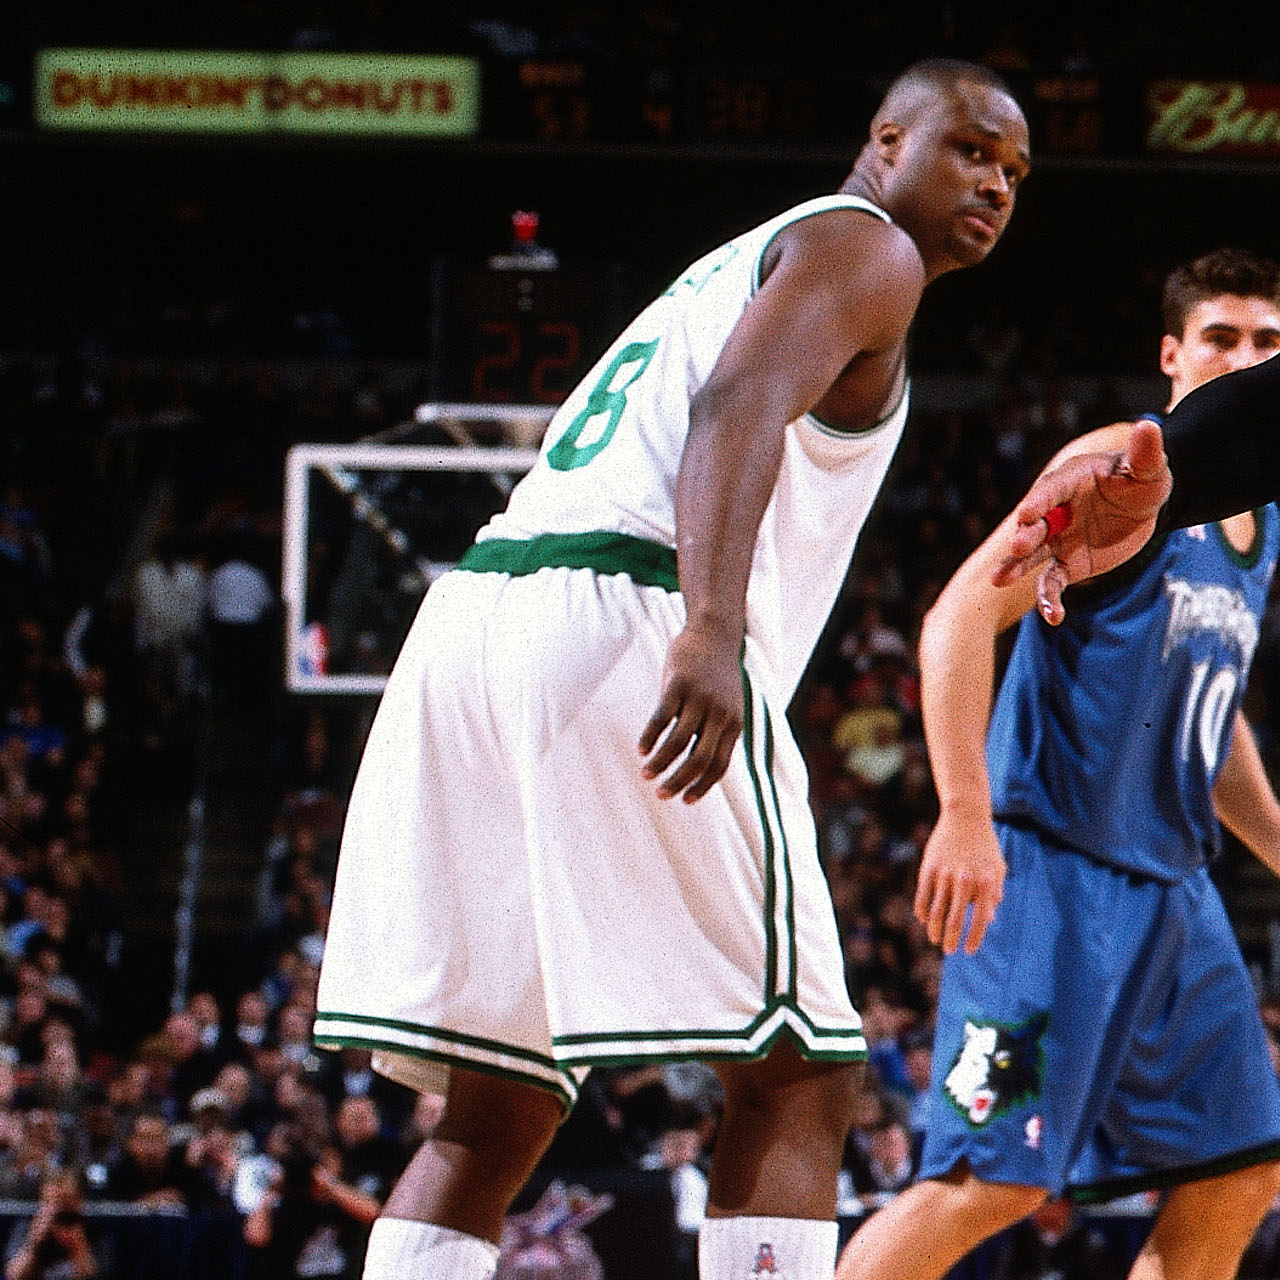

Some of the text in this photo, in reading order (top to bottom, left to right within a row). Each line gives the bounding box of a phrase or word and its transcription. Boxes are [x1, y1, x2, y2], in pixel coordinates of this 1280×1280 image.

[265, 74, 454, 113] DONUTS
[547, 336, 660, 472] 8
[1181, 662, 1237, 774] 10
